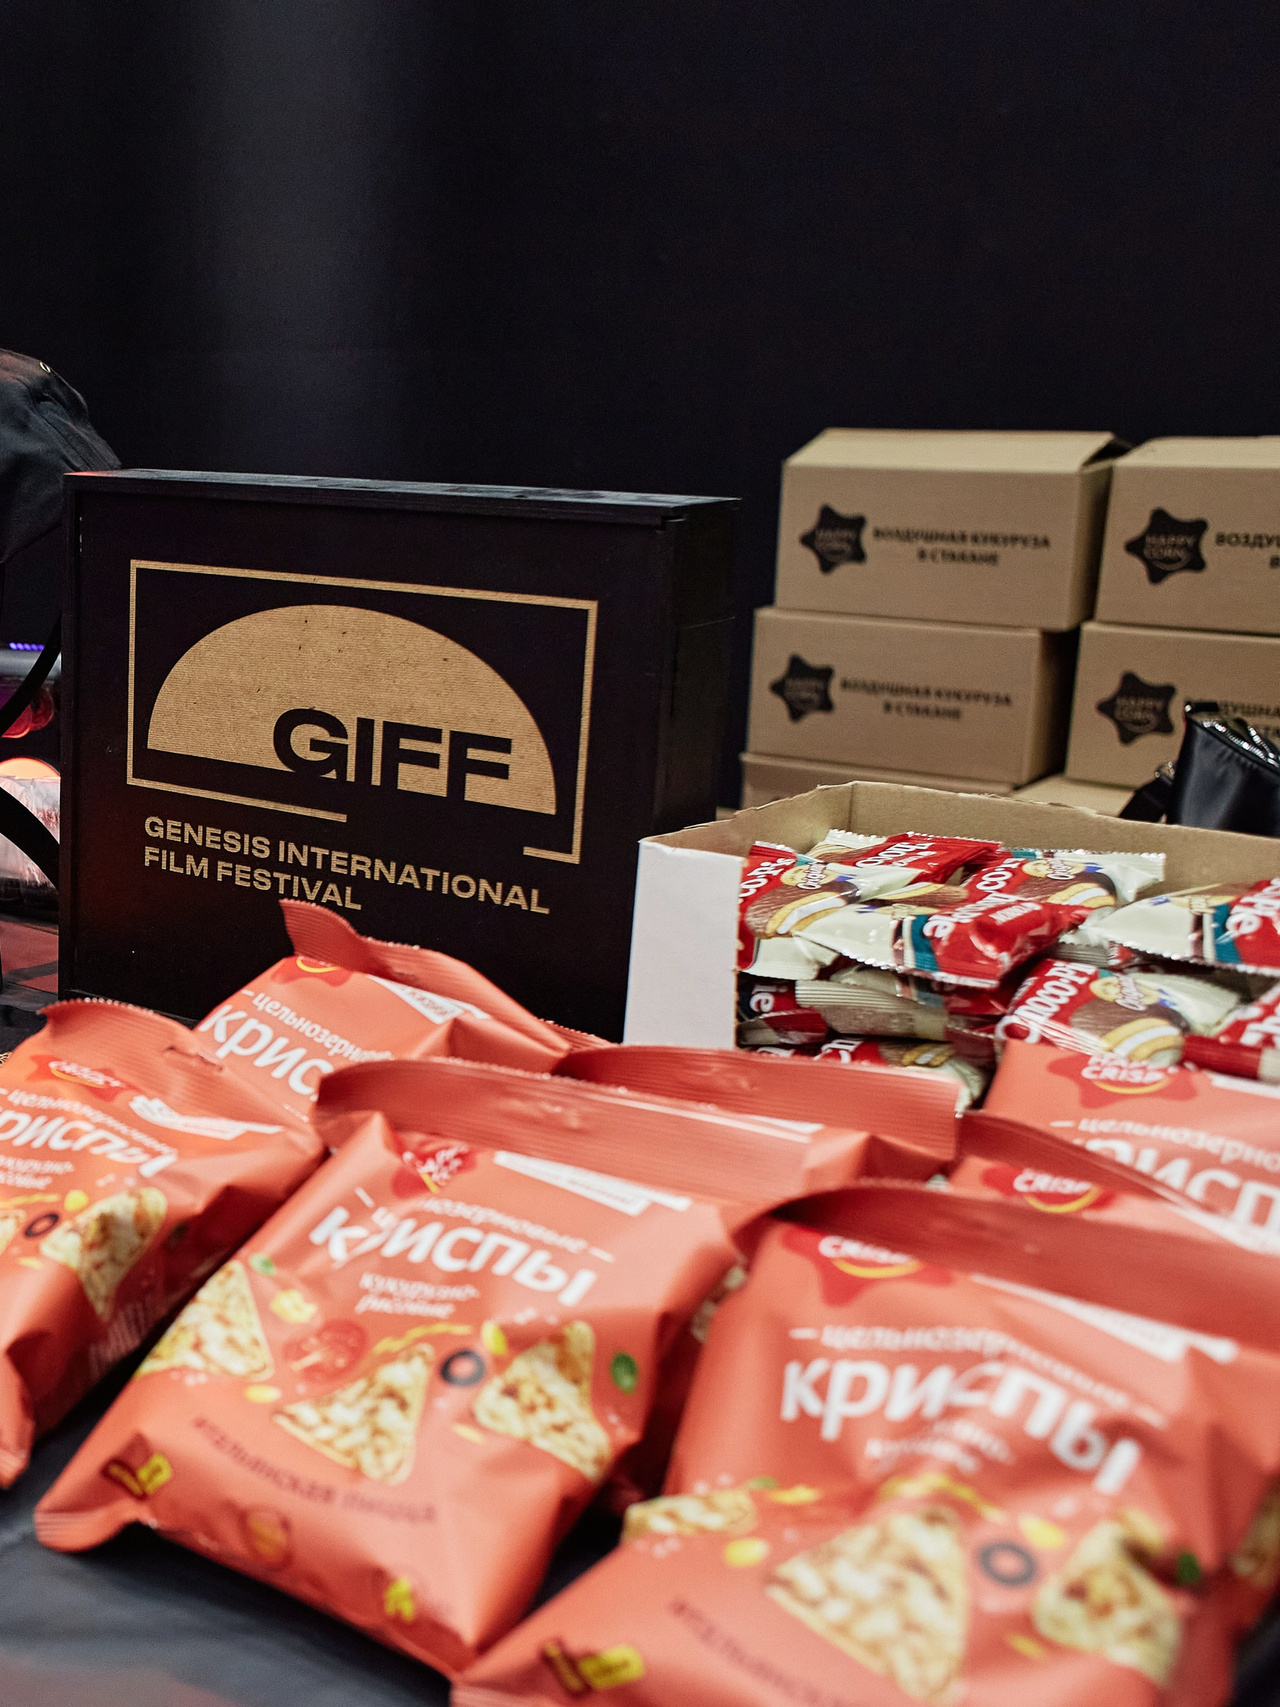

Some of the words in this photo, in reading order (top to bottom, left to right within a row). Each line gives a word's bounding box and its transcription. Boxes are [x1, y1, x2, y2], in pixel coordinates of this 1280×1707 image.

[873, 527, 968, 544] ВОЗДУШНАЯ
[971, 530, 1051, 549] КУКУРУЗА
[929, 548, 999, 567] СТАКАНЕ
[272, 707, 513, 802] GIFF
[143, 815, 271, 859] GENESIS
[278, 839, 551, 915] INTERNATIONAL
[143, 846, 209, 879] FILM
[217, 860, 362, 911] FESTIVAL
[198, 1003, 335, 1102] крис
